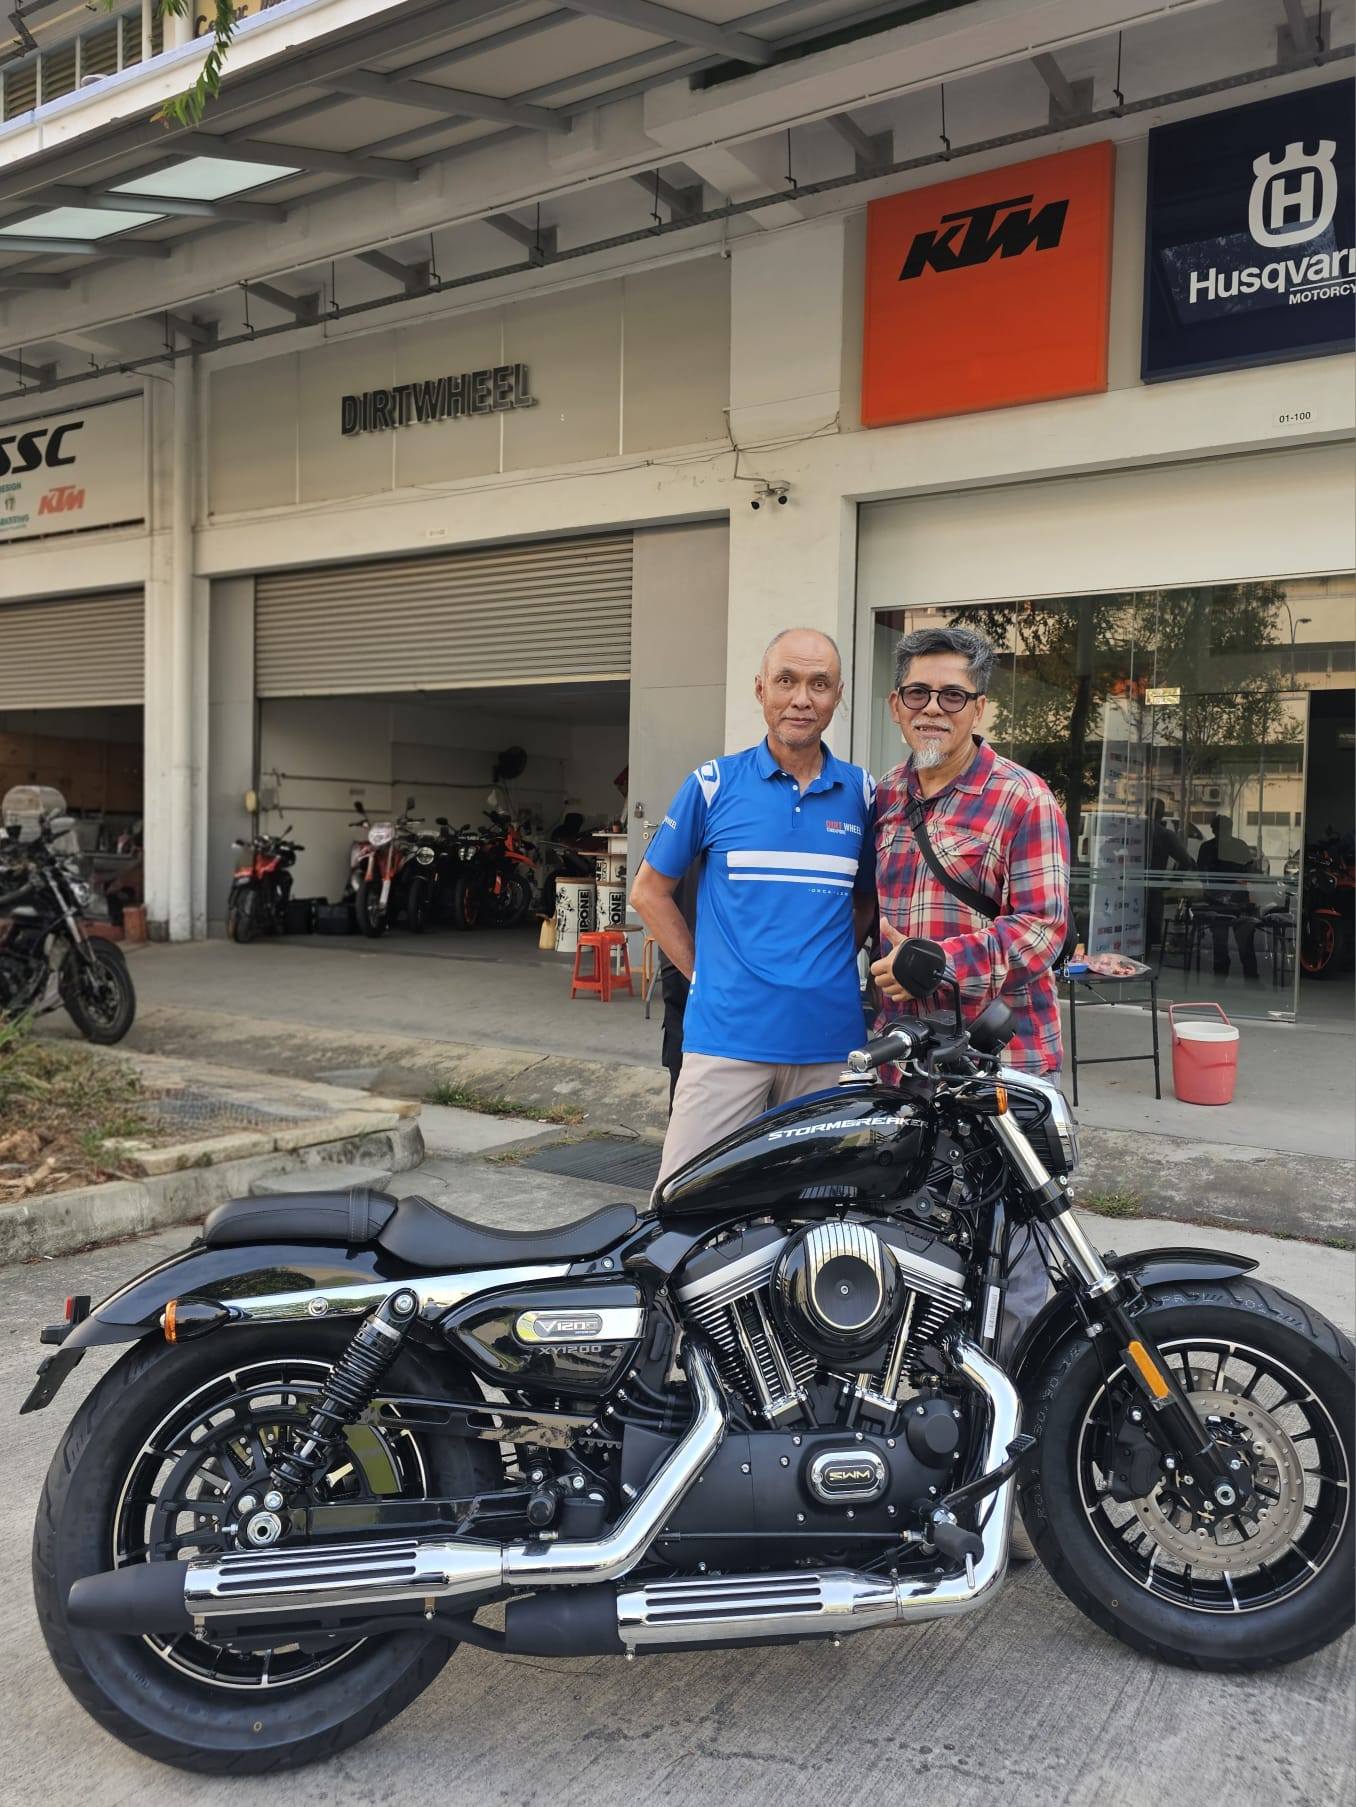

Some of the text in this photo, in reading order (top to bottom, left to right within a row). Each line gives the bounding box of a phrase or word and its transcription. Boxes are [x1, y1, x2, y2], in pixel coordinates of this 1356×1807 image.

[898, 194, 1070, 281] KTM
[1189, 247, 1356, 304] Husqvar
[341, 363, 536, 436] DIRTWHEEL
[1279, 411, 1311, 423] 01-100
[38, 485, 85, 516] KTM
[844, 822, 862, 835] WHEEL
[611, 893, 622, 924] ONE
[768, 1117, 929, 1141] STORMBREAKER
[539, 1345, 601, 1355] XY1200
[829, 1470, 870, 1480] SWM
